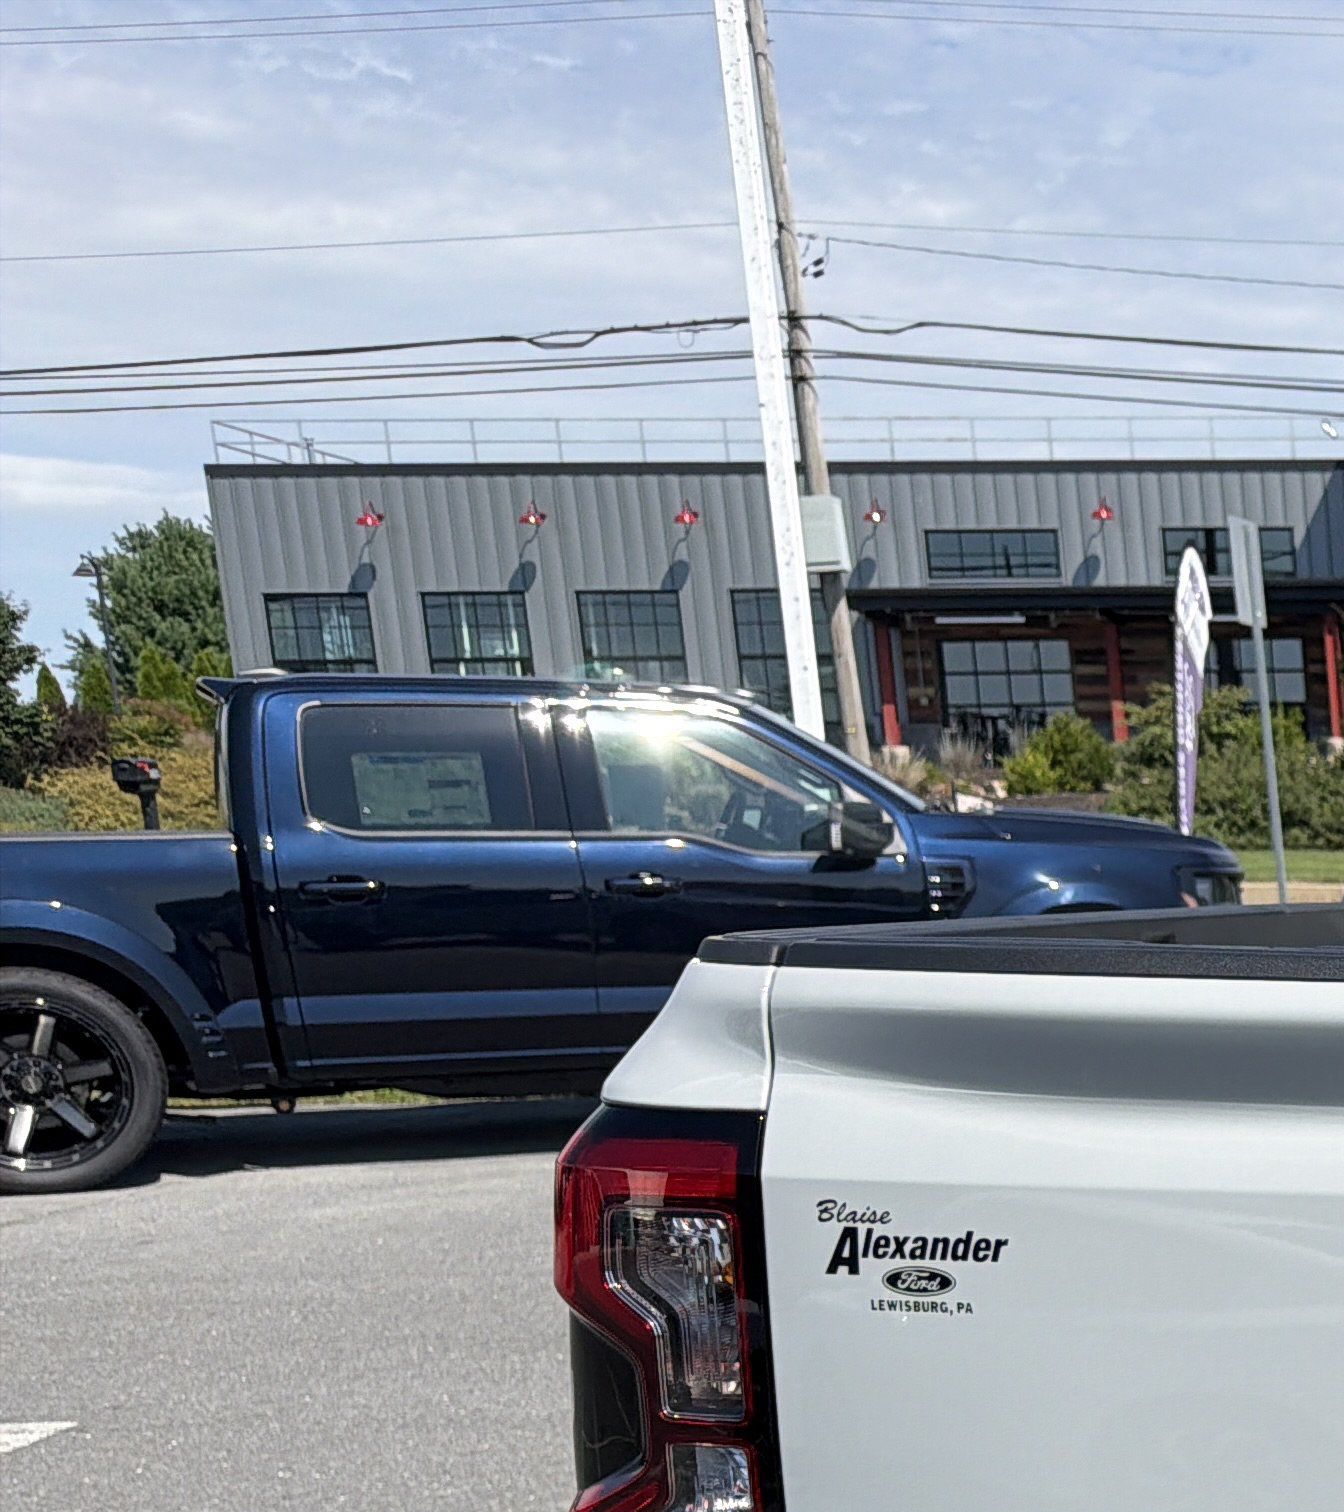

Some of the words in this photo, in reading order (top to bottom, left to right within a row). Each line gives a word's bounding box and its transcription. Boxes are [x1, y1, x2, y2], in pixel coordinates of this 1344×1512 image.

[816, 1198, 892, 1225] Blaise
[825, 1226, 1009, 1275] Alexander
[896, 1270, 941, 1292] Ford
[870, 1299, 954, 1316] LEWISBURG,
[957, 1302, 974, 1315] PA
